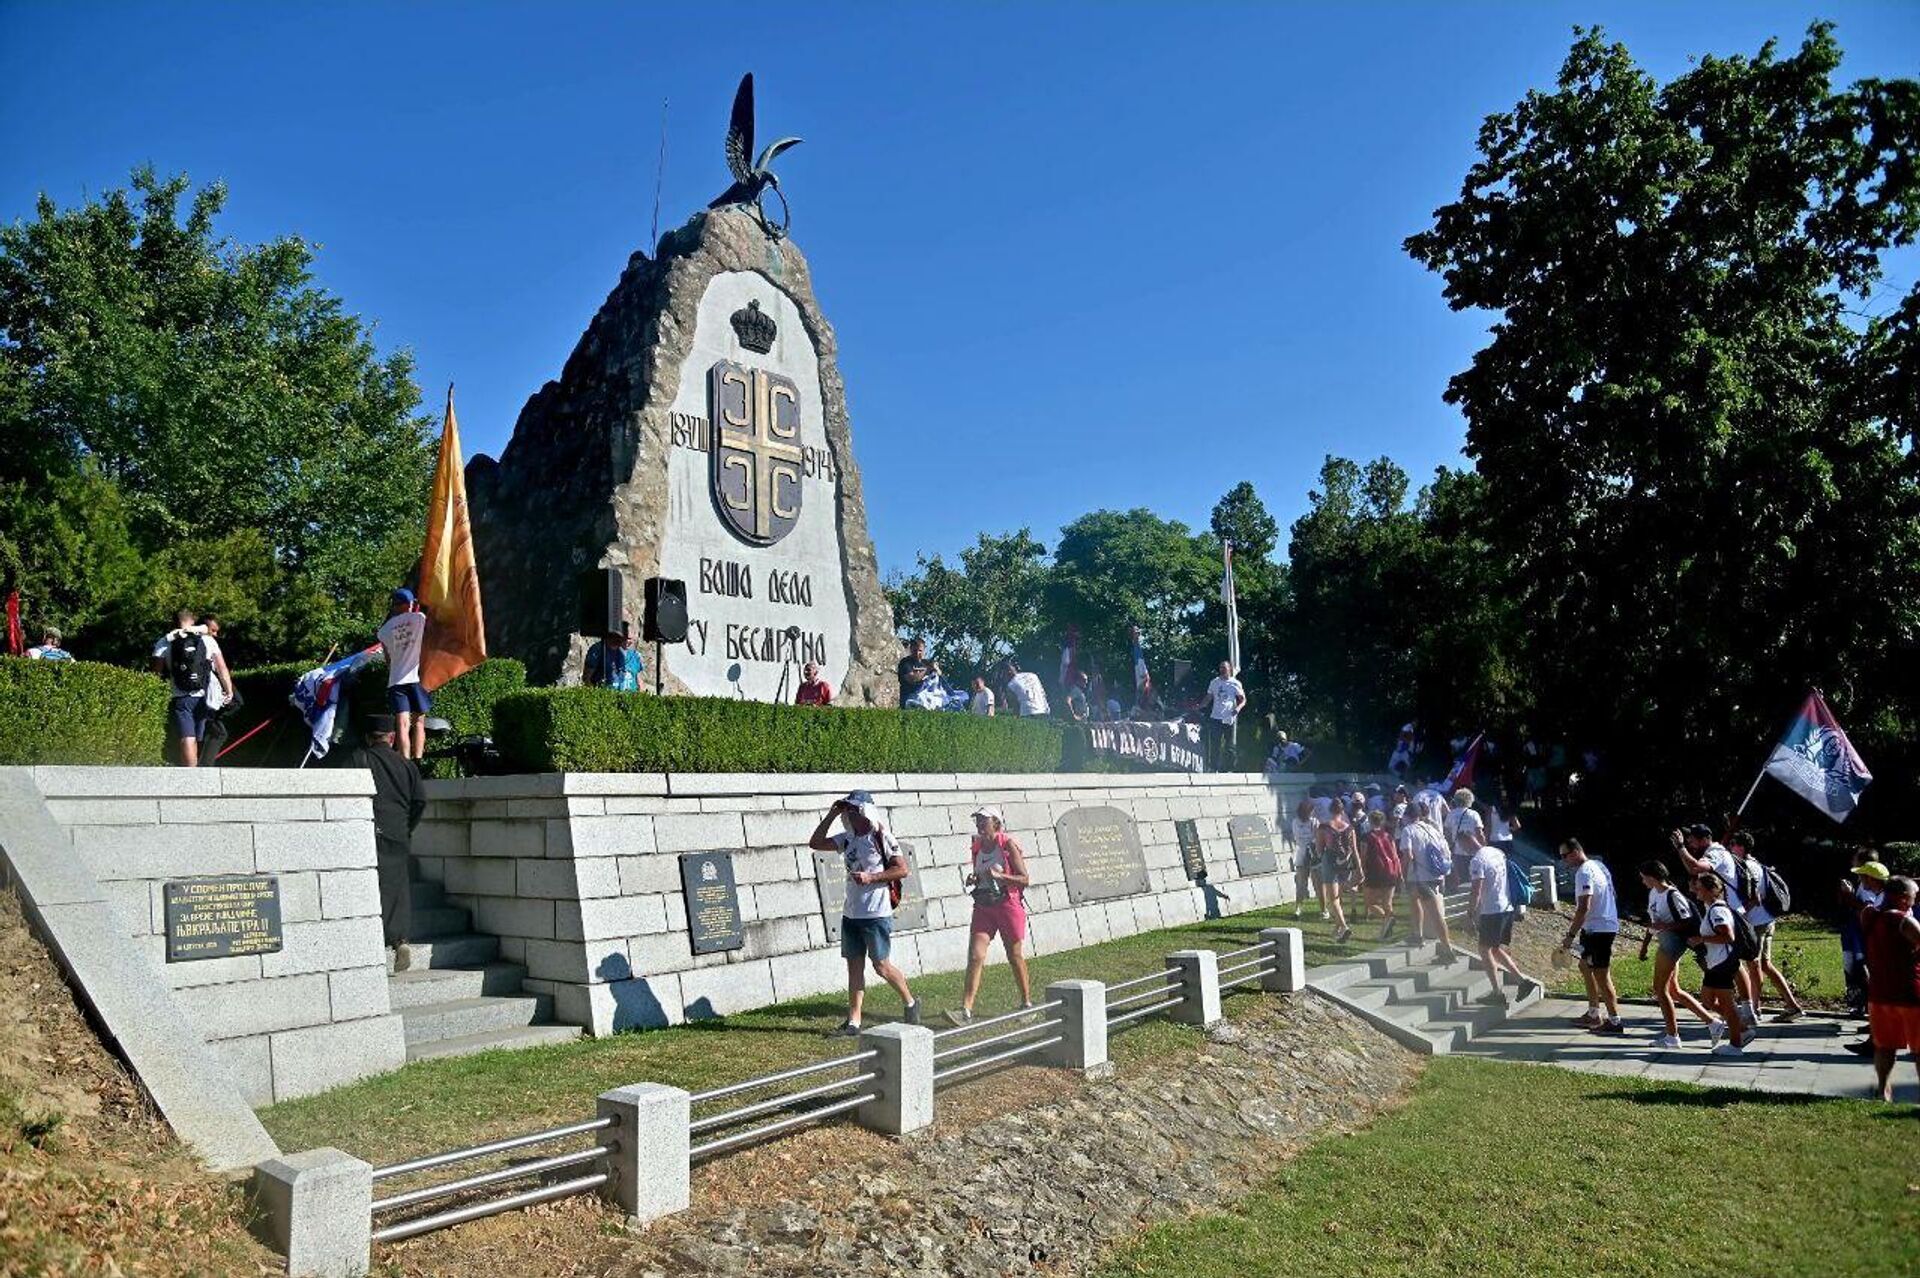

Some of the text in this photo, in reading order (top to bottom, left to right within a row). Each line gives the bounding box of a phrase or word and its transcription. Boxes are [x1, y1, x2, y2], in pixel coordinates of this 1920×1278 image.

[699, 556, 813, 608] ВАША ДЕЛА
[686, 618, 709, 657] СУ
